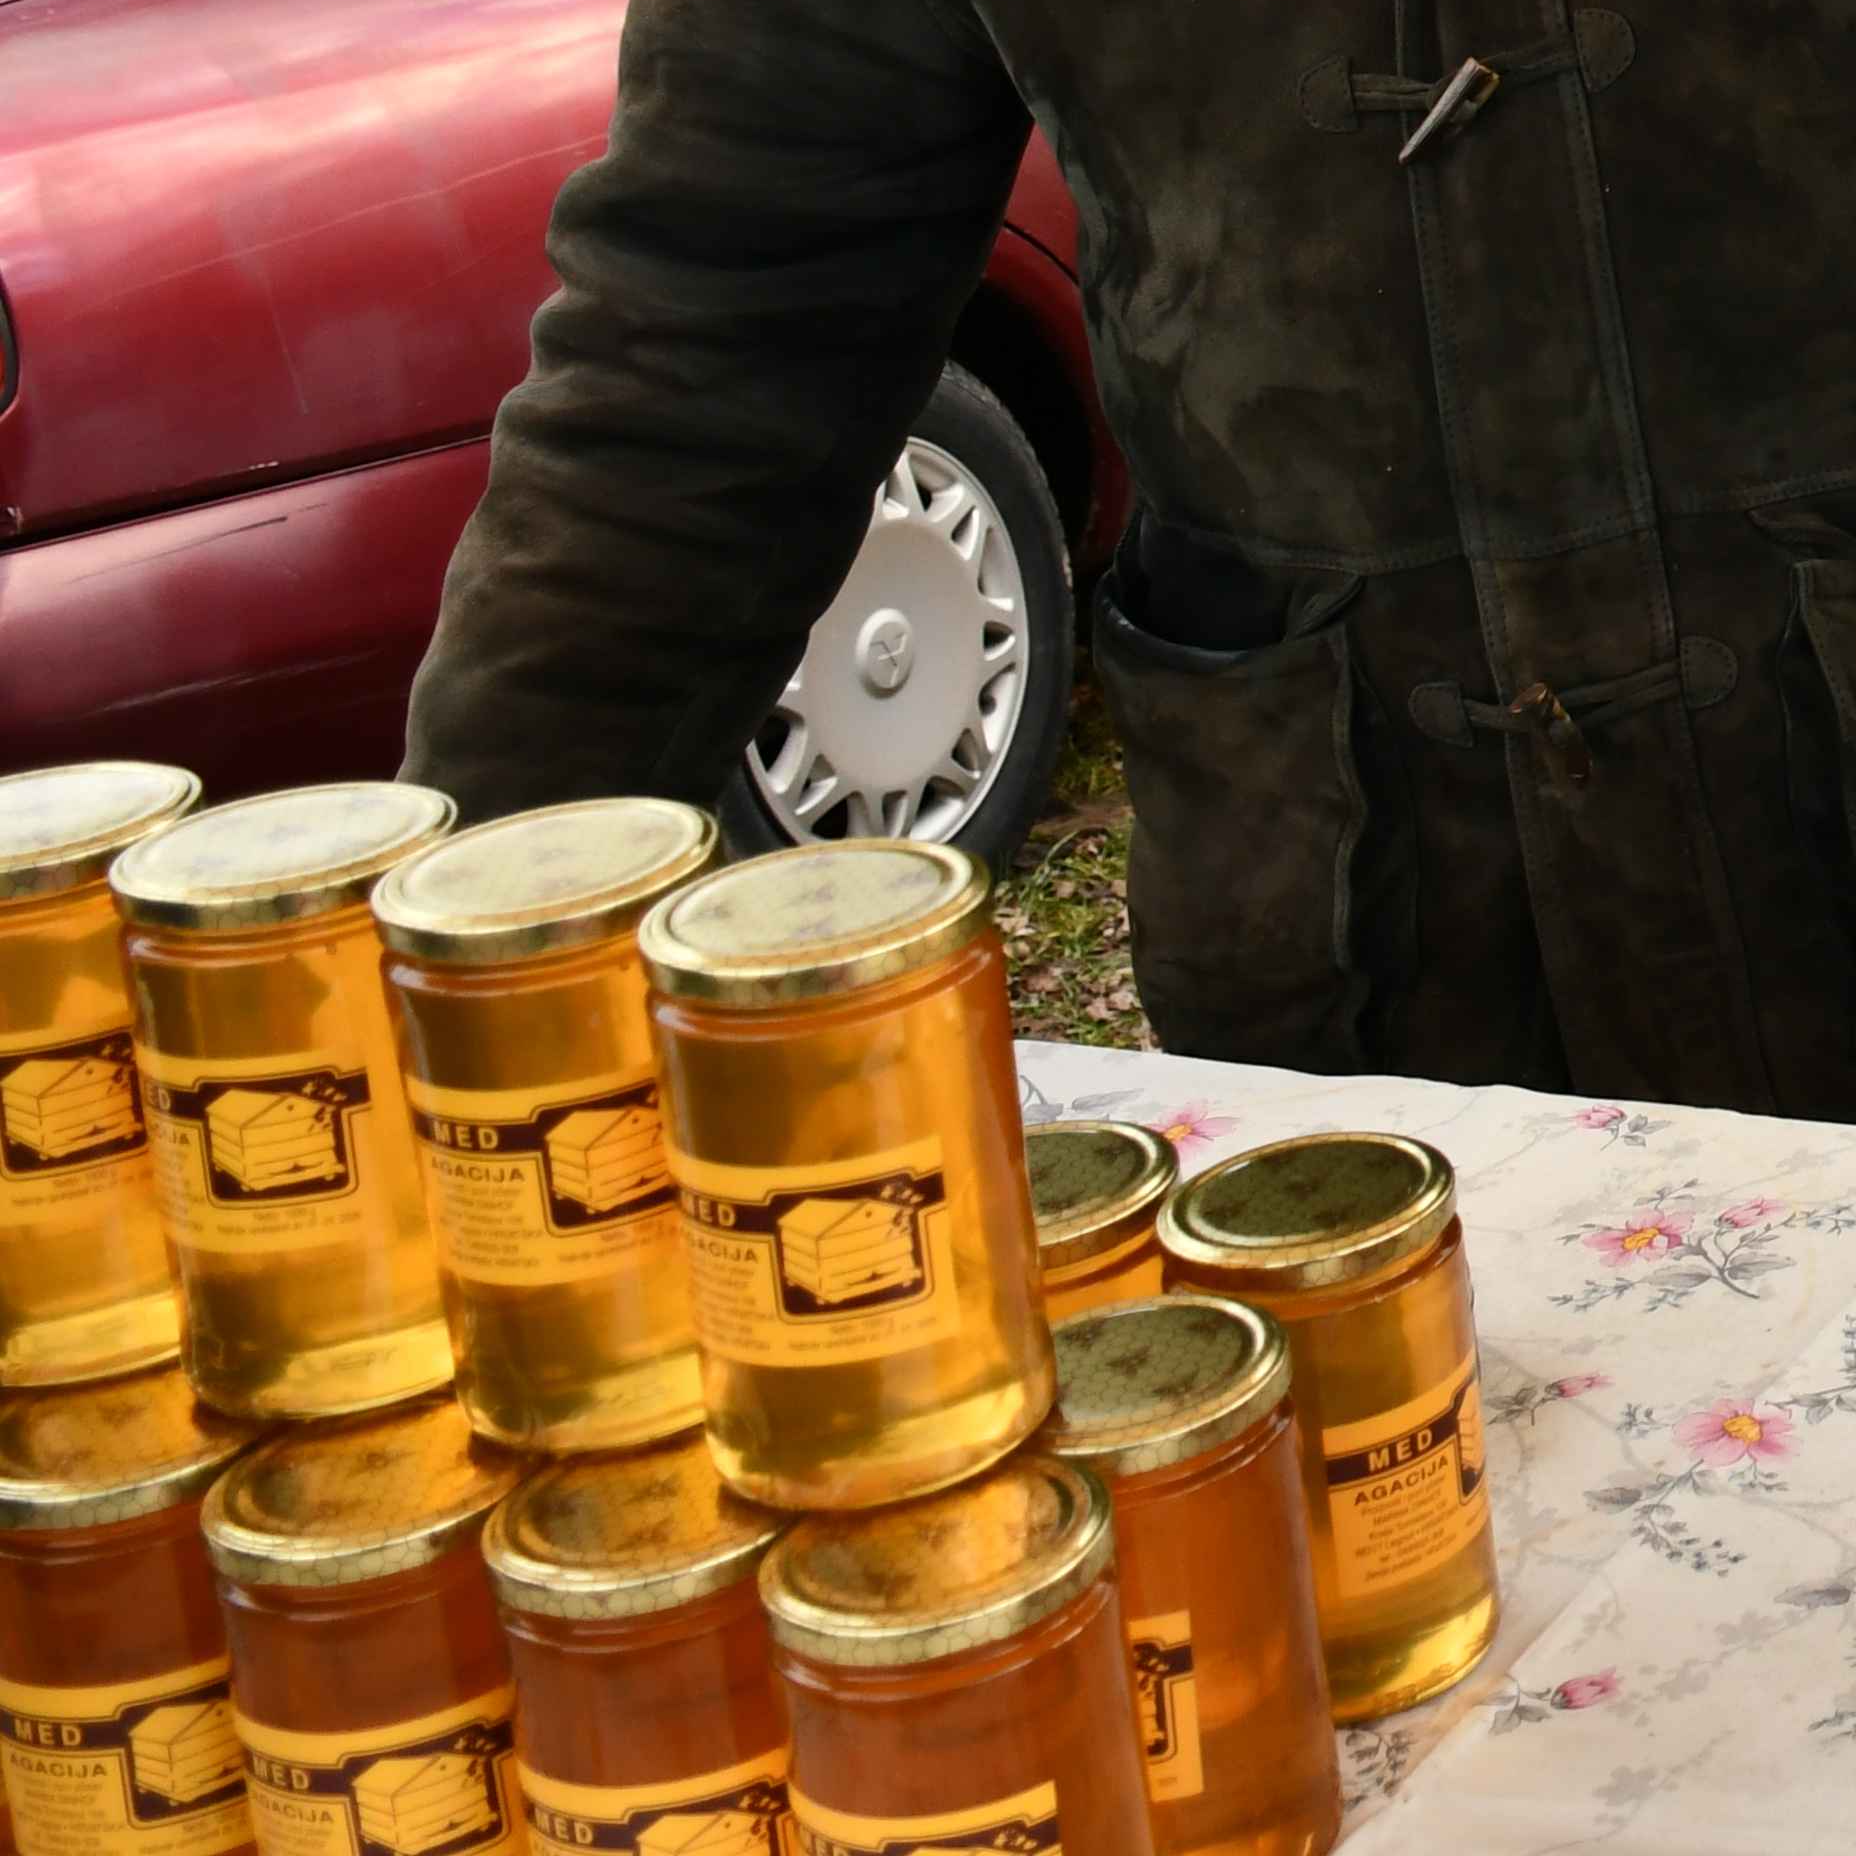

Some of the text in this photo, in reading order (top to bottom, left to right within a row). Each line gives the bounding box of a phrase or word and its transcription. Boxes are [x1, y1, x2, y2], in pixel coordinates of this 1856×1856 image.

[432, 1119, 500, 1150] MED
[1367, 1427, 1433, 1472] MED
[1353, 1454, 1449, 1506] AGACIJA
[14, 1718, 82, 1746] MED
[252, 1751, 310, 1790] MED
[533, 1806, 594, 1844] MED
